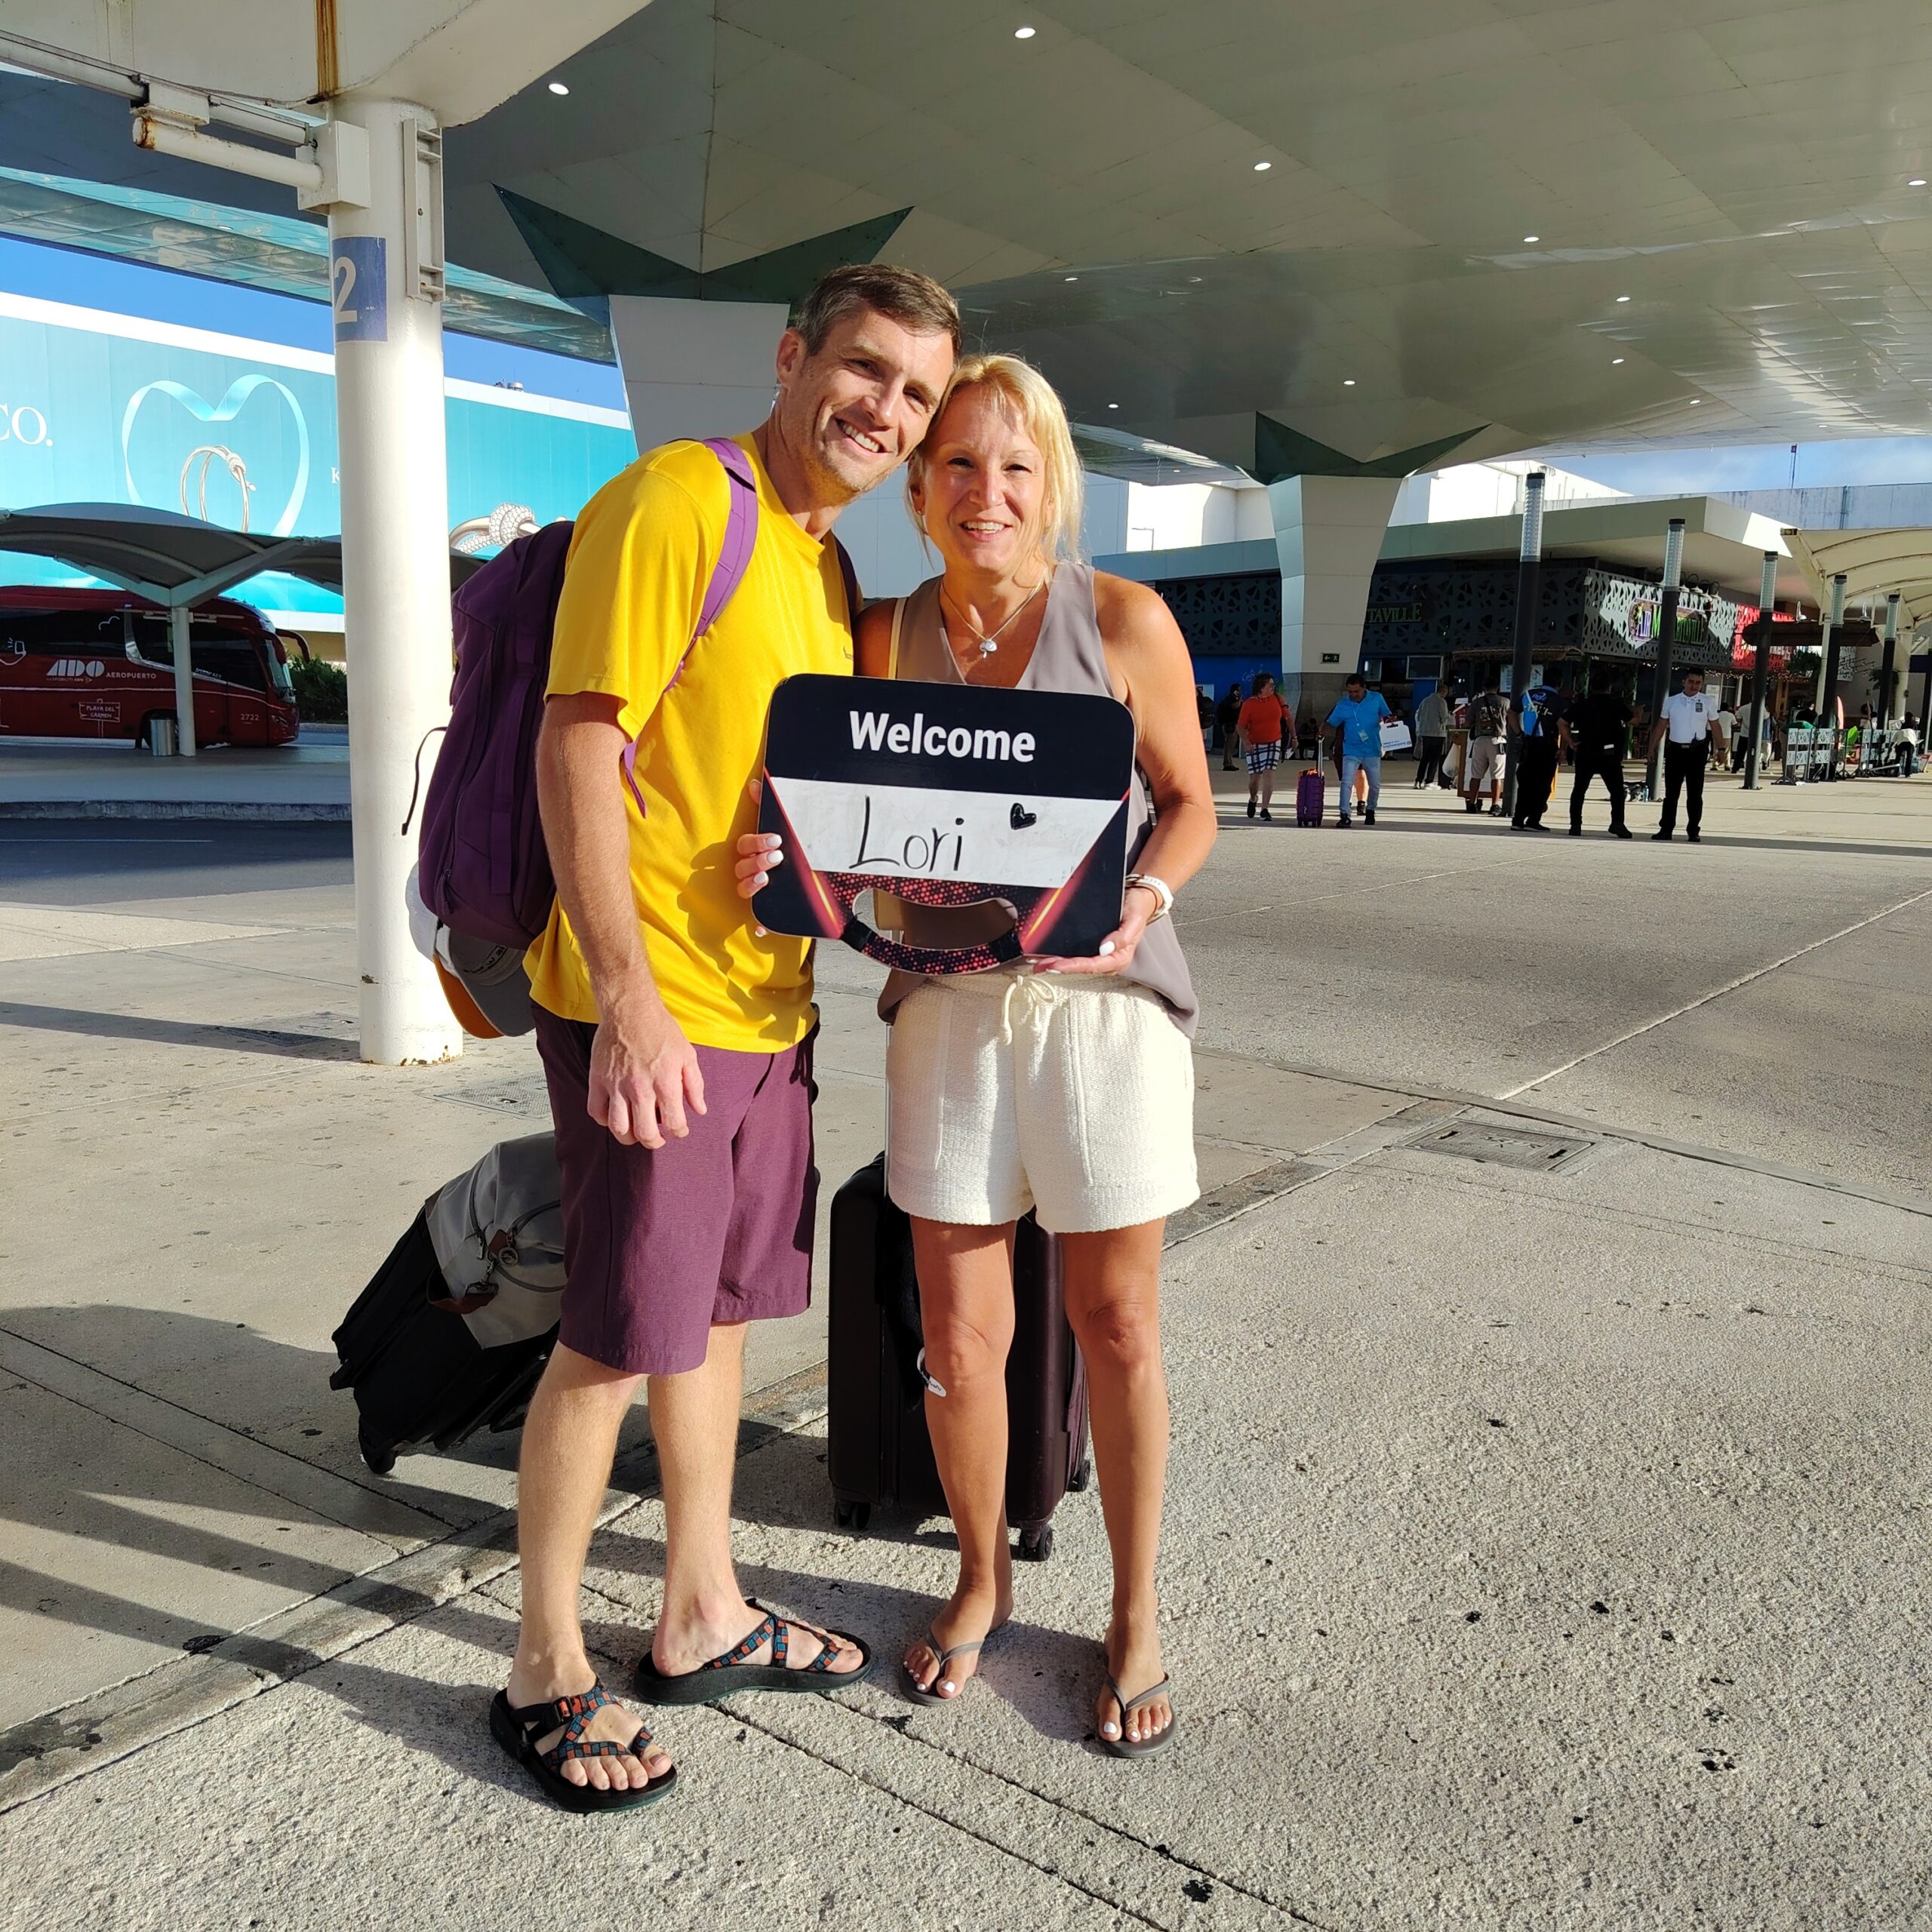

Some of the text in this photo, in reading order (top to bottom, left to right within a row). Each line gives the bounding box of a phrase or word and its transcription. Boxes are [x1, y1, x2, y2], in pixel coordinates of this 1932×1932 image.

[334, 257, 358, 325] 2
[0, 403, 54, 447] O.
[1367, 603, 1422, 623] TAVILLE
[46, 659, 105, 677] ADO
[850, 711, 1035, 762] Welcome
[849, 795, 964, 872] Lori
